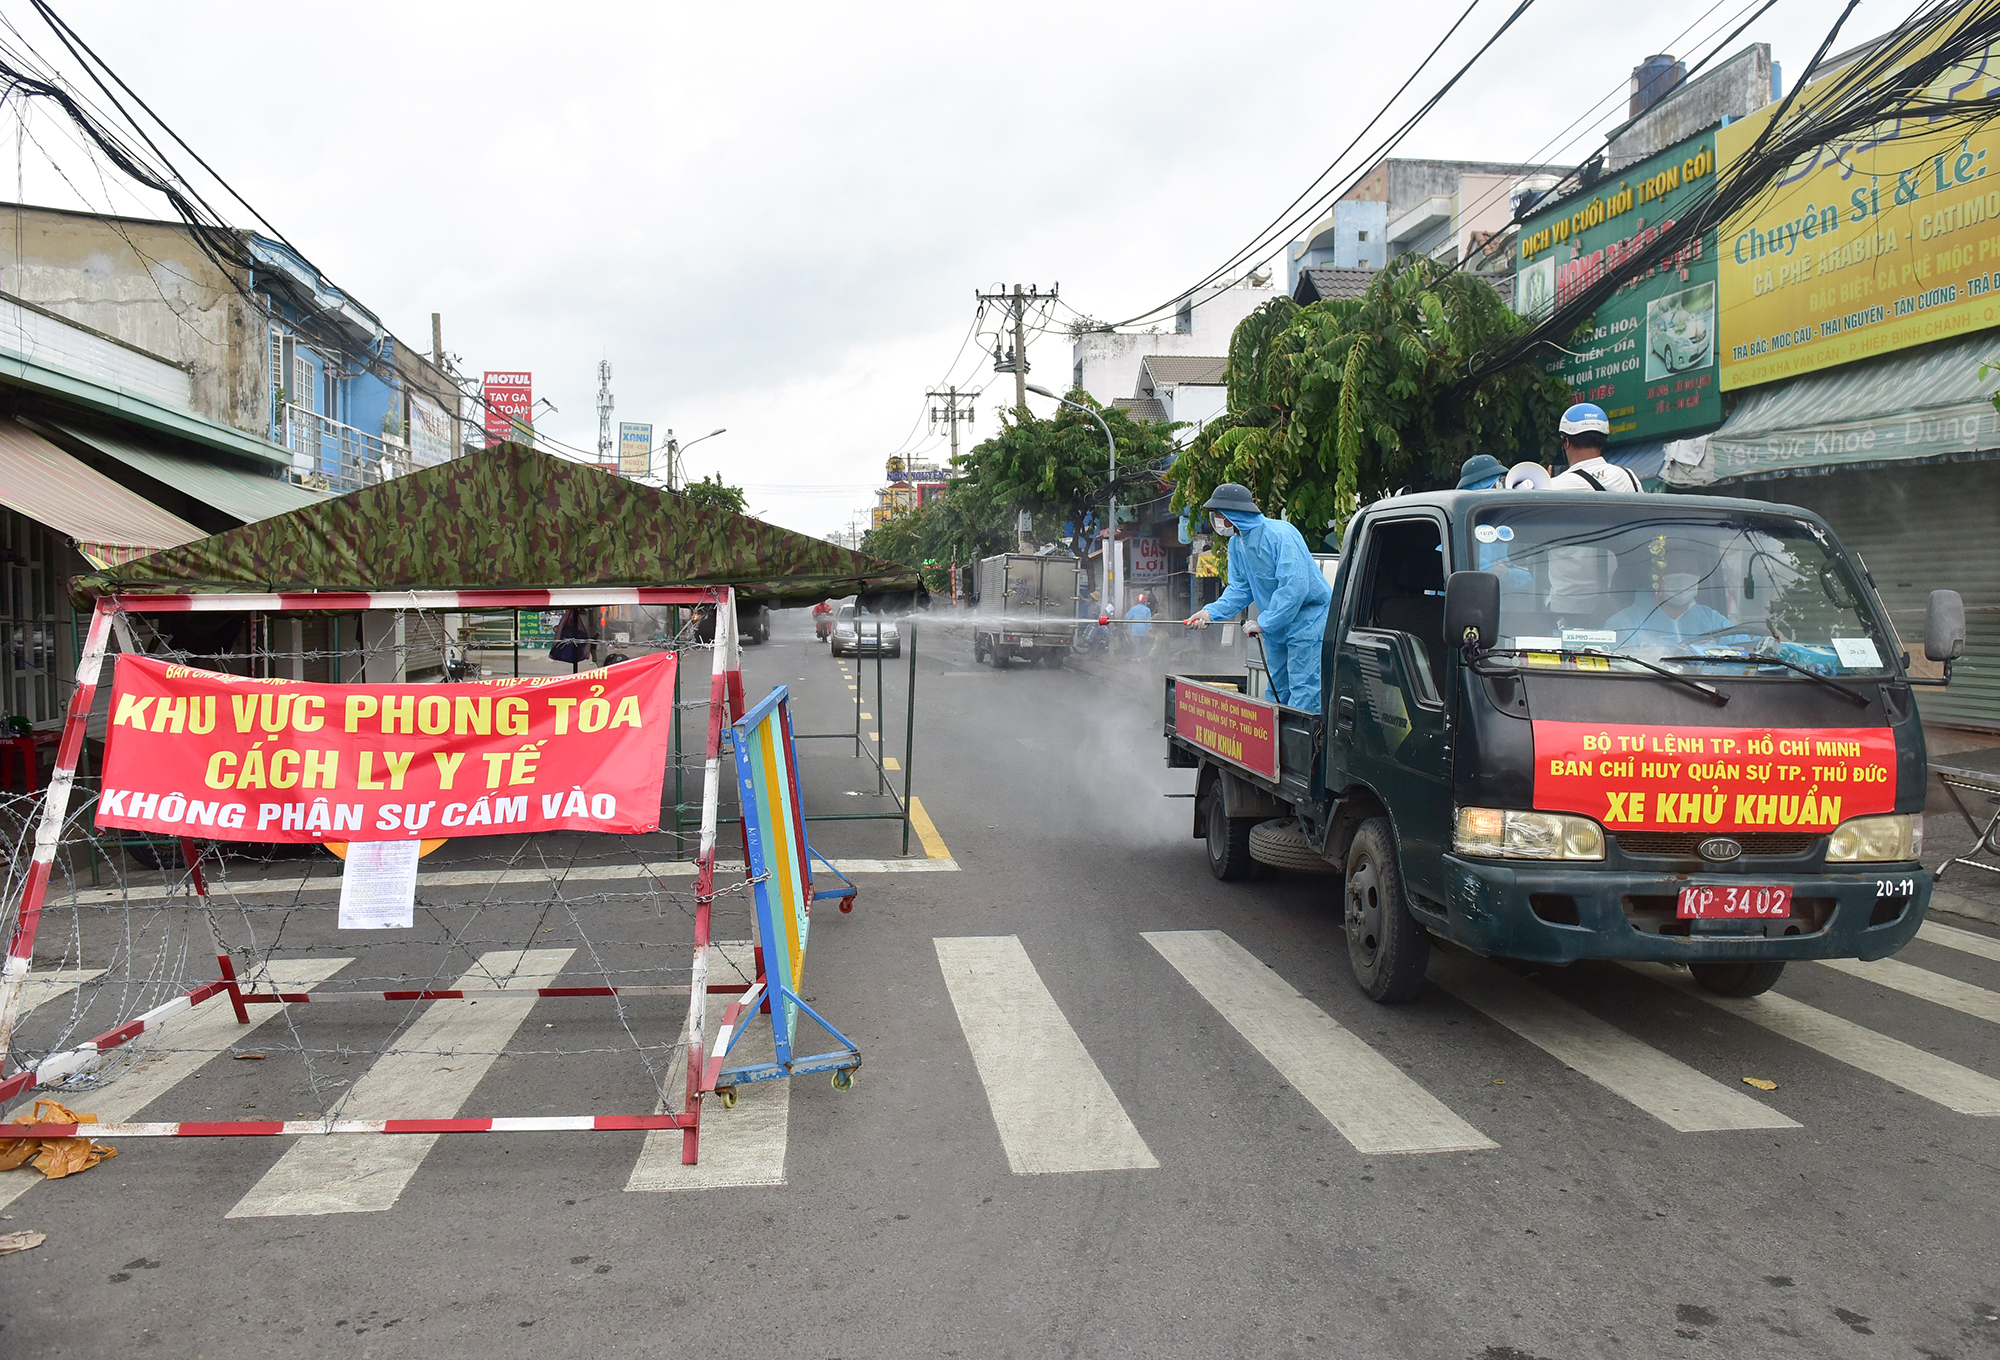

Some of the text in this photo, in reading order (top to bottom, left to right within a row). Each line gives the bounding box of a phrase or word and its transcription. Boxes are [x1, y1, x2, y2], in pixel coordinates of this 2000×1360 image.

[1522, 145, 1714, 261] DỊCH VỤ CƯỚI HỎI TRỌN GÓI
[1733, 203, 1839, 265] Chuyên
[1849, 176, 1880, 222] Sỉ
[1893, 167, 1920, 207] &
[1933, 139, 1988, 192] Lẻ:
[1753, 271, 1775, 297] CÀ
[1778, 255, 1812, 289] PHÊ
[1816, 227, 1899, 276] ARABICA
[1936, 243, 1974, 274] MỘC
[1610, 316, 1638, 334] HOA
[1732, 341, 1748, 361] TRÀ
[1820, 315, 1842, 338] THÁI
[1844, 303, 1884, 331] NGUYÊN
[1893, 296, 1915, 317] TÂN
[1917, 284, 1956, 310] CƯƠNG
[1967, 271, 1991, 297] TRÀ
[486, 373, 531, 385] MOTUL
[1595, 361, 1620, 379] TRỌN
[1621, 354, 1640, 372] GÓI
[489, 392, 528, 402] TAY GA
[498, 404, 529, 415] TOÀN
[1766, 437, 1805, 463] Sức
[1141, 539, 1167, 558] GAS
[166, 665, 189, 679] BAN
[112, 685, 643, 741] KHU VỰC PHONG TỎA
[1240, 708, 1257, 721] MINH
[1195, 724, 1203, 743] XE
[1583, 731, 1861, 757] BỘ TƯ LỆNH TP. HỒ CHÍ MINH
[204, 739, 549, 790] CÁCH LY Y TẾ
[1550, 756, 1888, 784] BAN CHỈ HUY QUÂN SỰ TP. THỦ ĐỨC
[98, 785, 616, 836] KHÔNG PHẬN SỰ CẤM VÀO
[1603, 784, 1842, 826] XE KHỬ KHUẨN
[1707, 844, 1734, 857] KIA
[1876, 879, 1914, 897] 20-11
